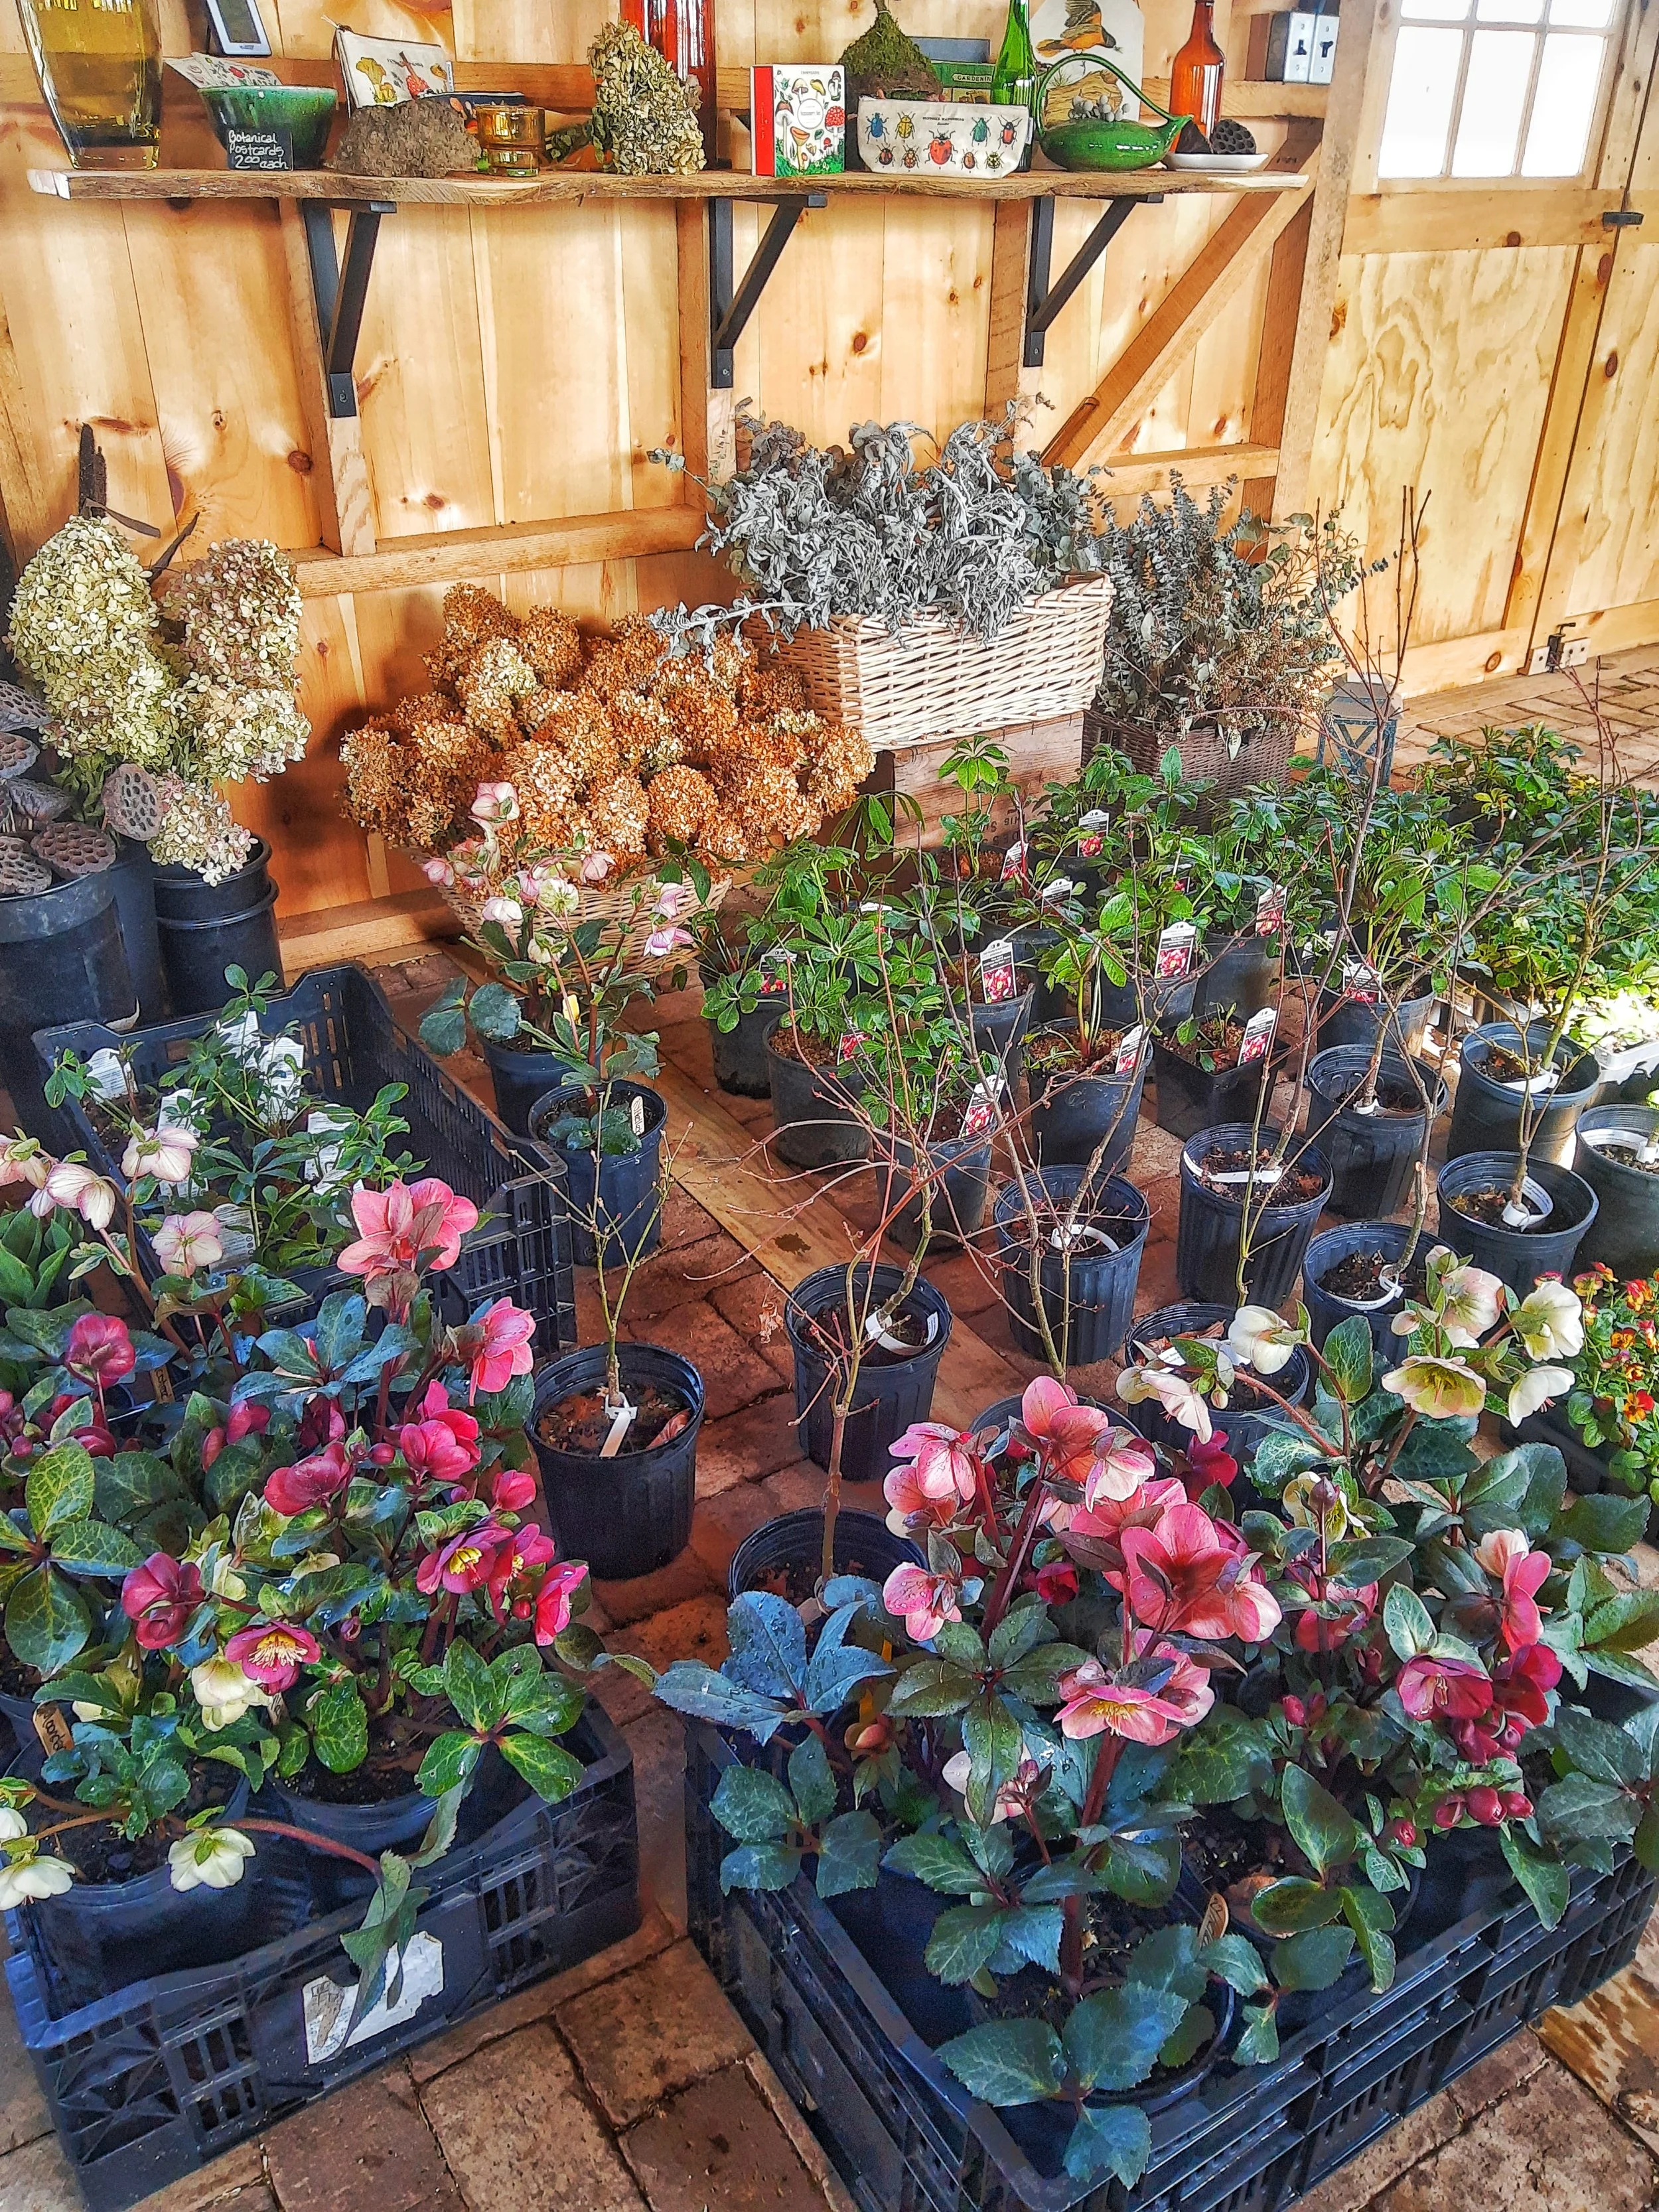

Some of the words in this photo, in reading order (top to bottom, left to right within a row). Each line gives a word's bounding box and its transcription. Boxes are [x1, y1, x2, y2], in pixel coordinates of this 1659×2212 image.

[228, 129, 277, 143] Botanical
[230, 142, 285, 157] Postcards
[259, 157, 289, 169] each
